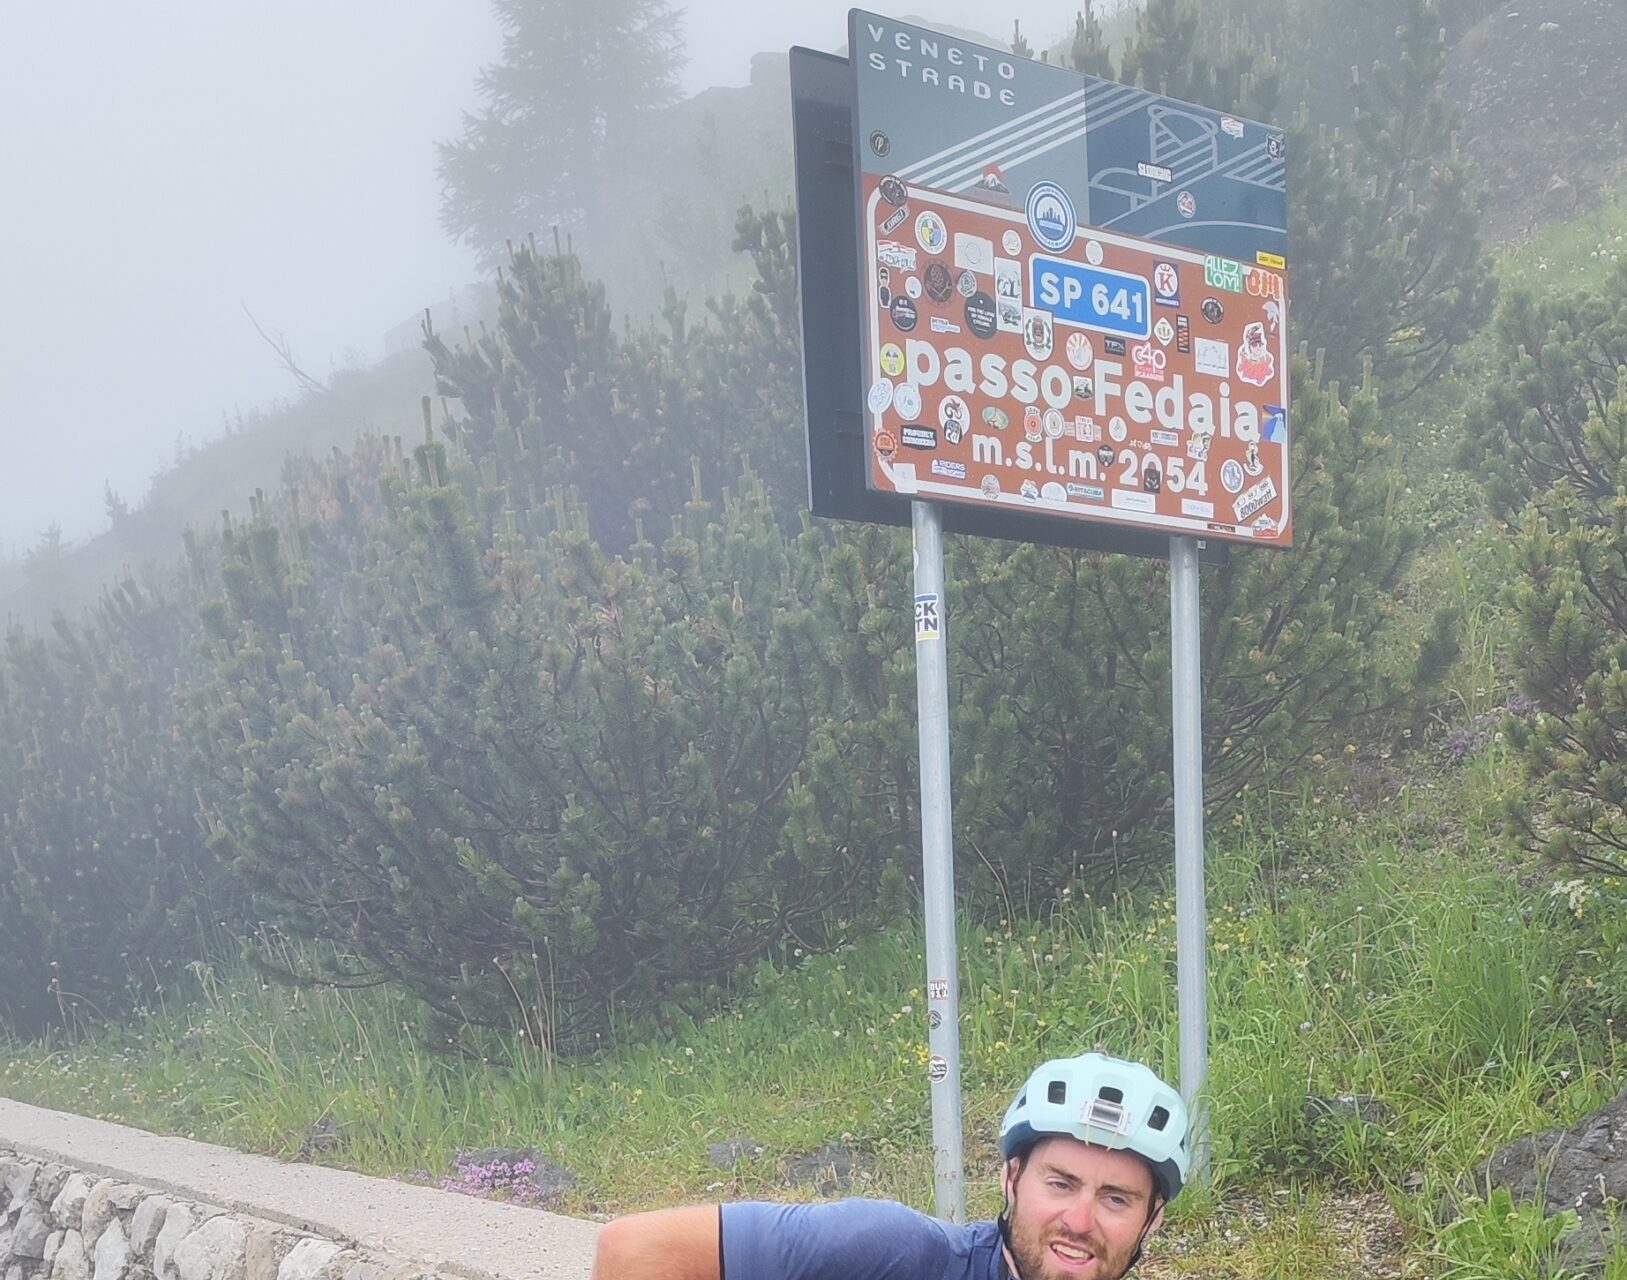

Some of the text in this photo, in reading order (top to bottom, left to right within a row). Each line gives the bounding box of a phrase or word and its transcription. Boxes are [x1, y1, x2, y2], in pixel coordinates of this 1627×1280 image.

[867, 23, 1015, 80] VENETO
[868, 52, 1016, 106] STRADE
[1039, 272, 1143, 323] SP 641
[1094, 358, 1261, 443] Fedaia
[972, 433, 1106, 481] m.s.l.m.
[1118, 448, 1209, 497] 2054
